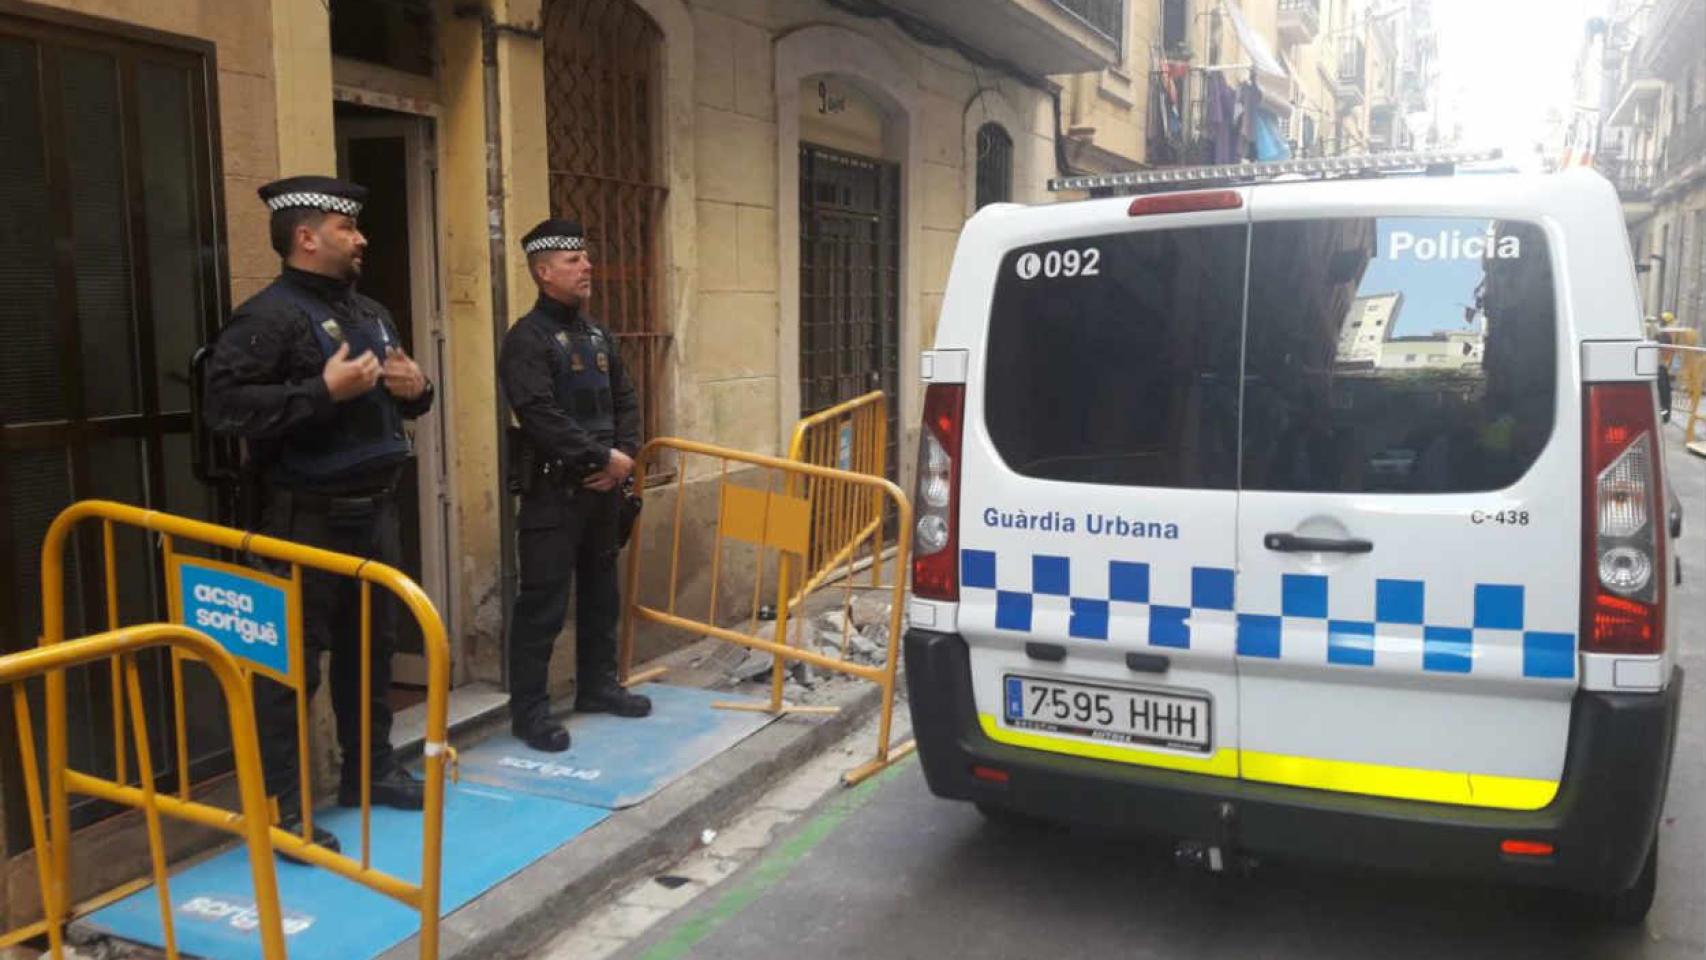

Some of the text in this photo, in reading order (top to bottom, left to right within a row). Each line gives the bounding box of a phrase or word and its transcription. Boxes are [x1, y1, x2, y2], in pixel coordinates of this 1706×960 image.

[1043, 247, 1100, 278] 092
[983, 507, 1180, 540] Guàrdia Urbana
[1470, 509, 1530, 526] C-438
[193, 583, 254, 614] acsa
[1029, 685, 1197, 739] 7595 HHH
